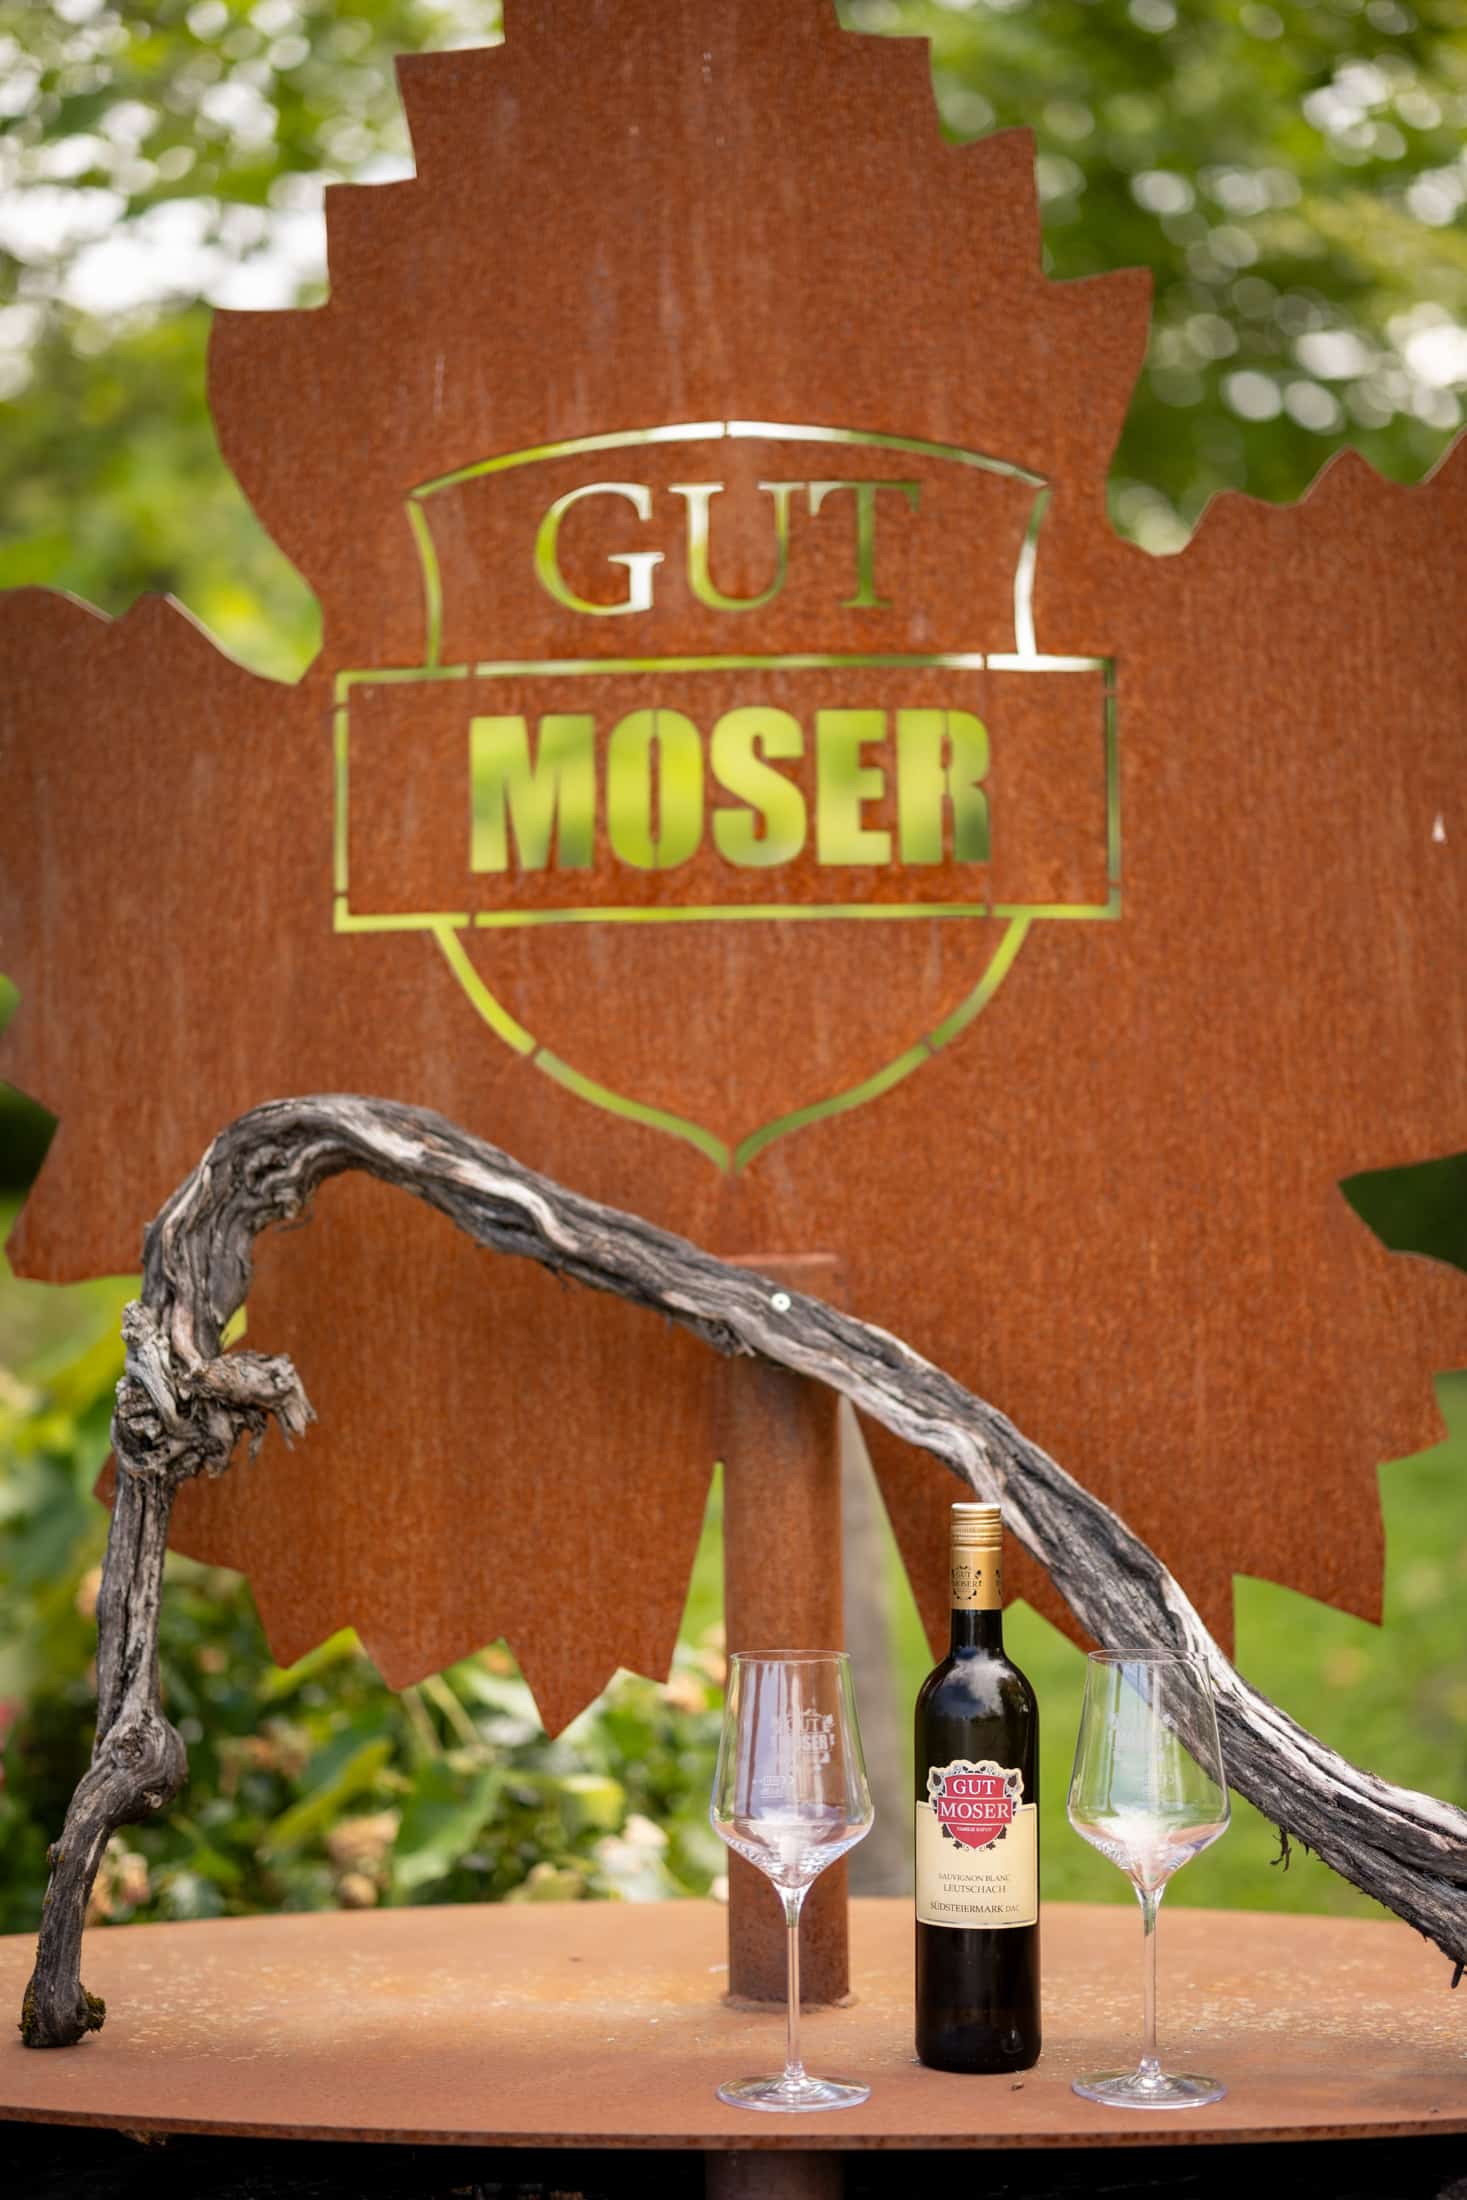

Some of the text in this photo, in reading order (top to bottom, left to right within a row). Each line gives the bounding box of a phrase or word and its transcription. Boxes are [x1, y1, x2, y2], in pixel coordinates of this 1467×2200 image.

[534, 481, 921, 616] GUT
[469, 706, 991, 874] MOSER
[953, 1779, 996, 1795] GUT
[940, 1801, 1010, 1819] MOSER
[943, 1884, 1007, 1894] LEUTSCHACH
